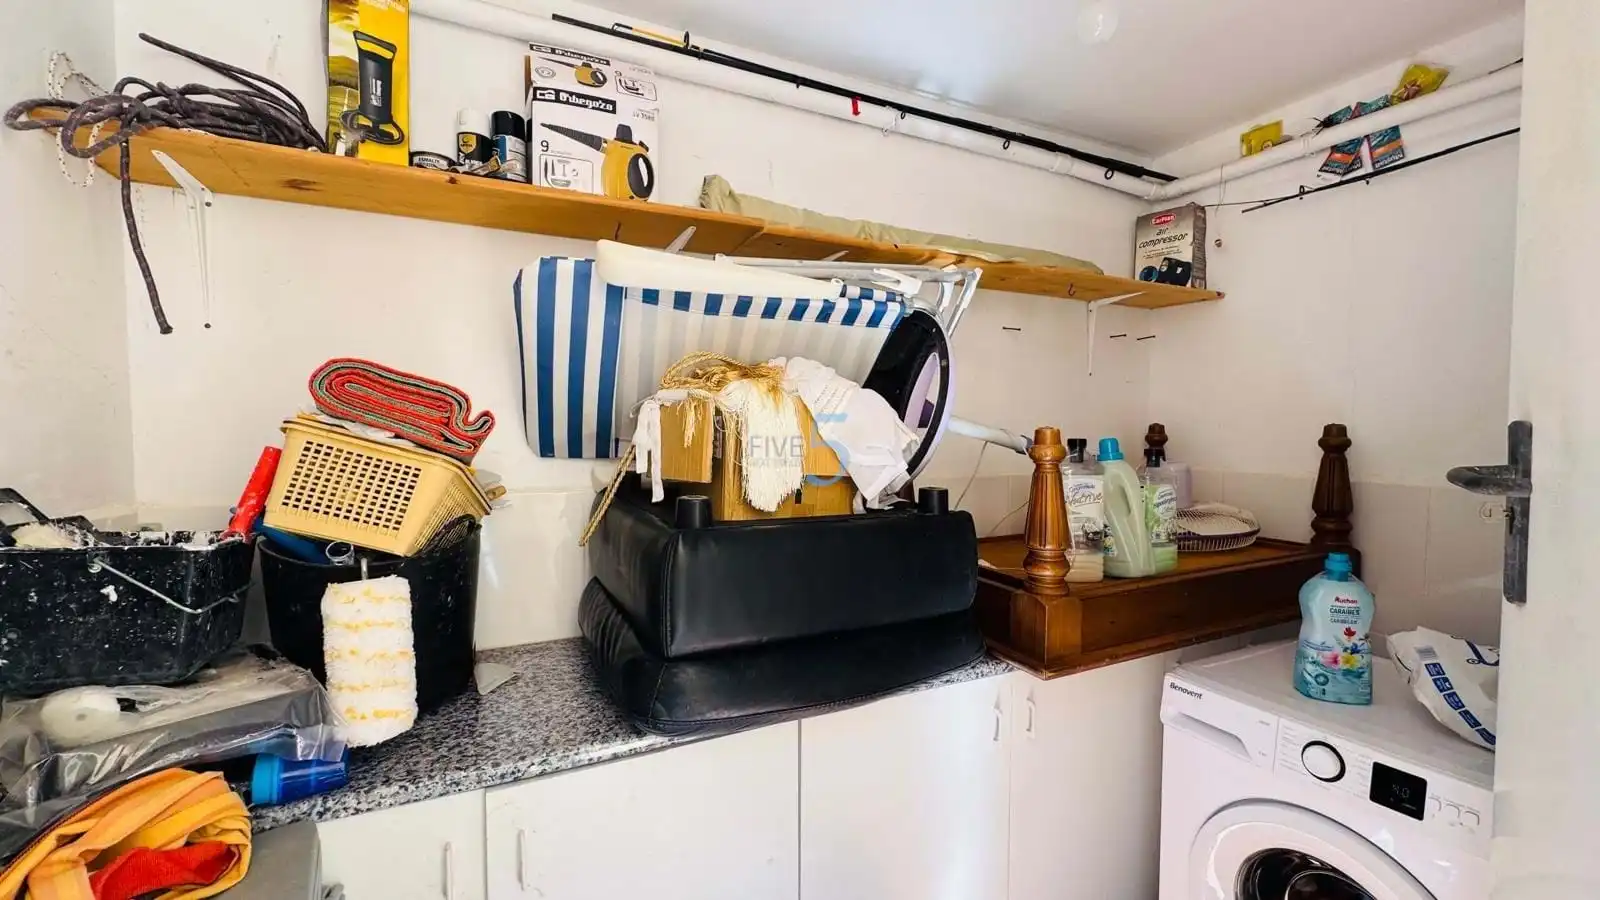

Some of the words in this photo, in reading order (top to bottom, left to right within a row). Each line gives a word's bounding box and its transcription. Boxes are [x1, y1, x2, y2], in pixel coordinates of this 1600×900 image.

[540, 140, 549, 153] 9
[1156, 227, 1169, 236] air
[1138, 233, 1189, 250] compressor
[1334, 596, 1358, 604] Auchan
[1169, 680, 1204, 701] Benavent
